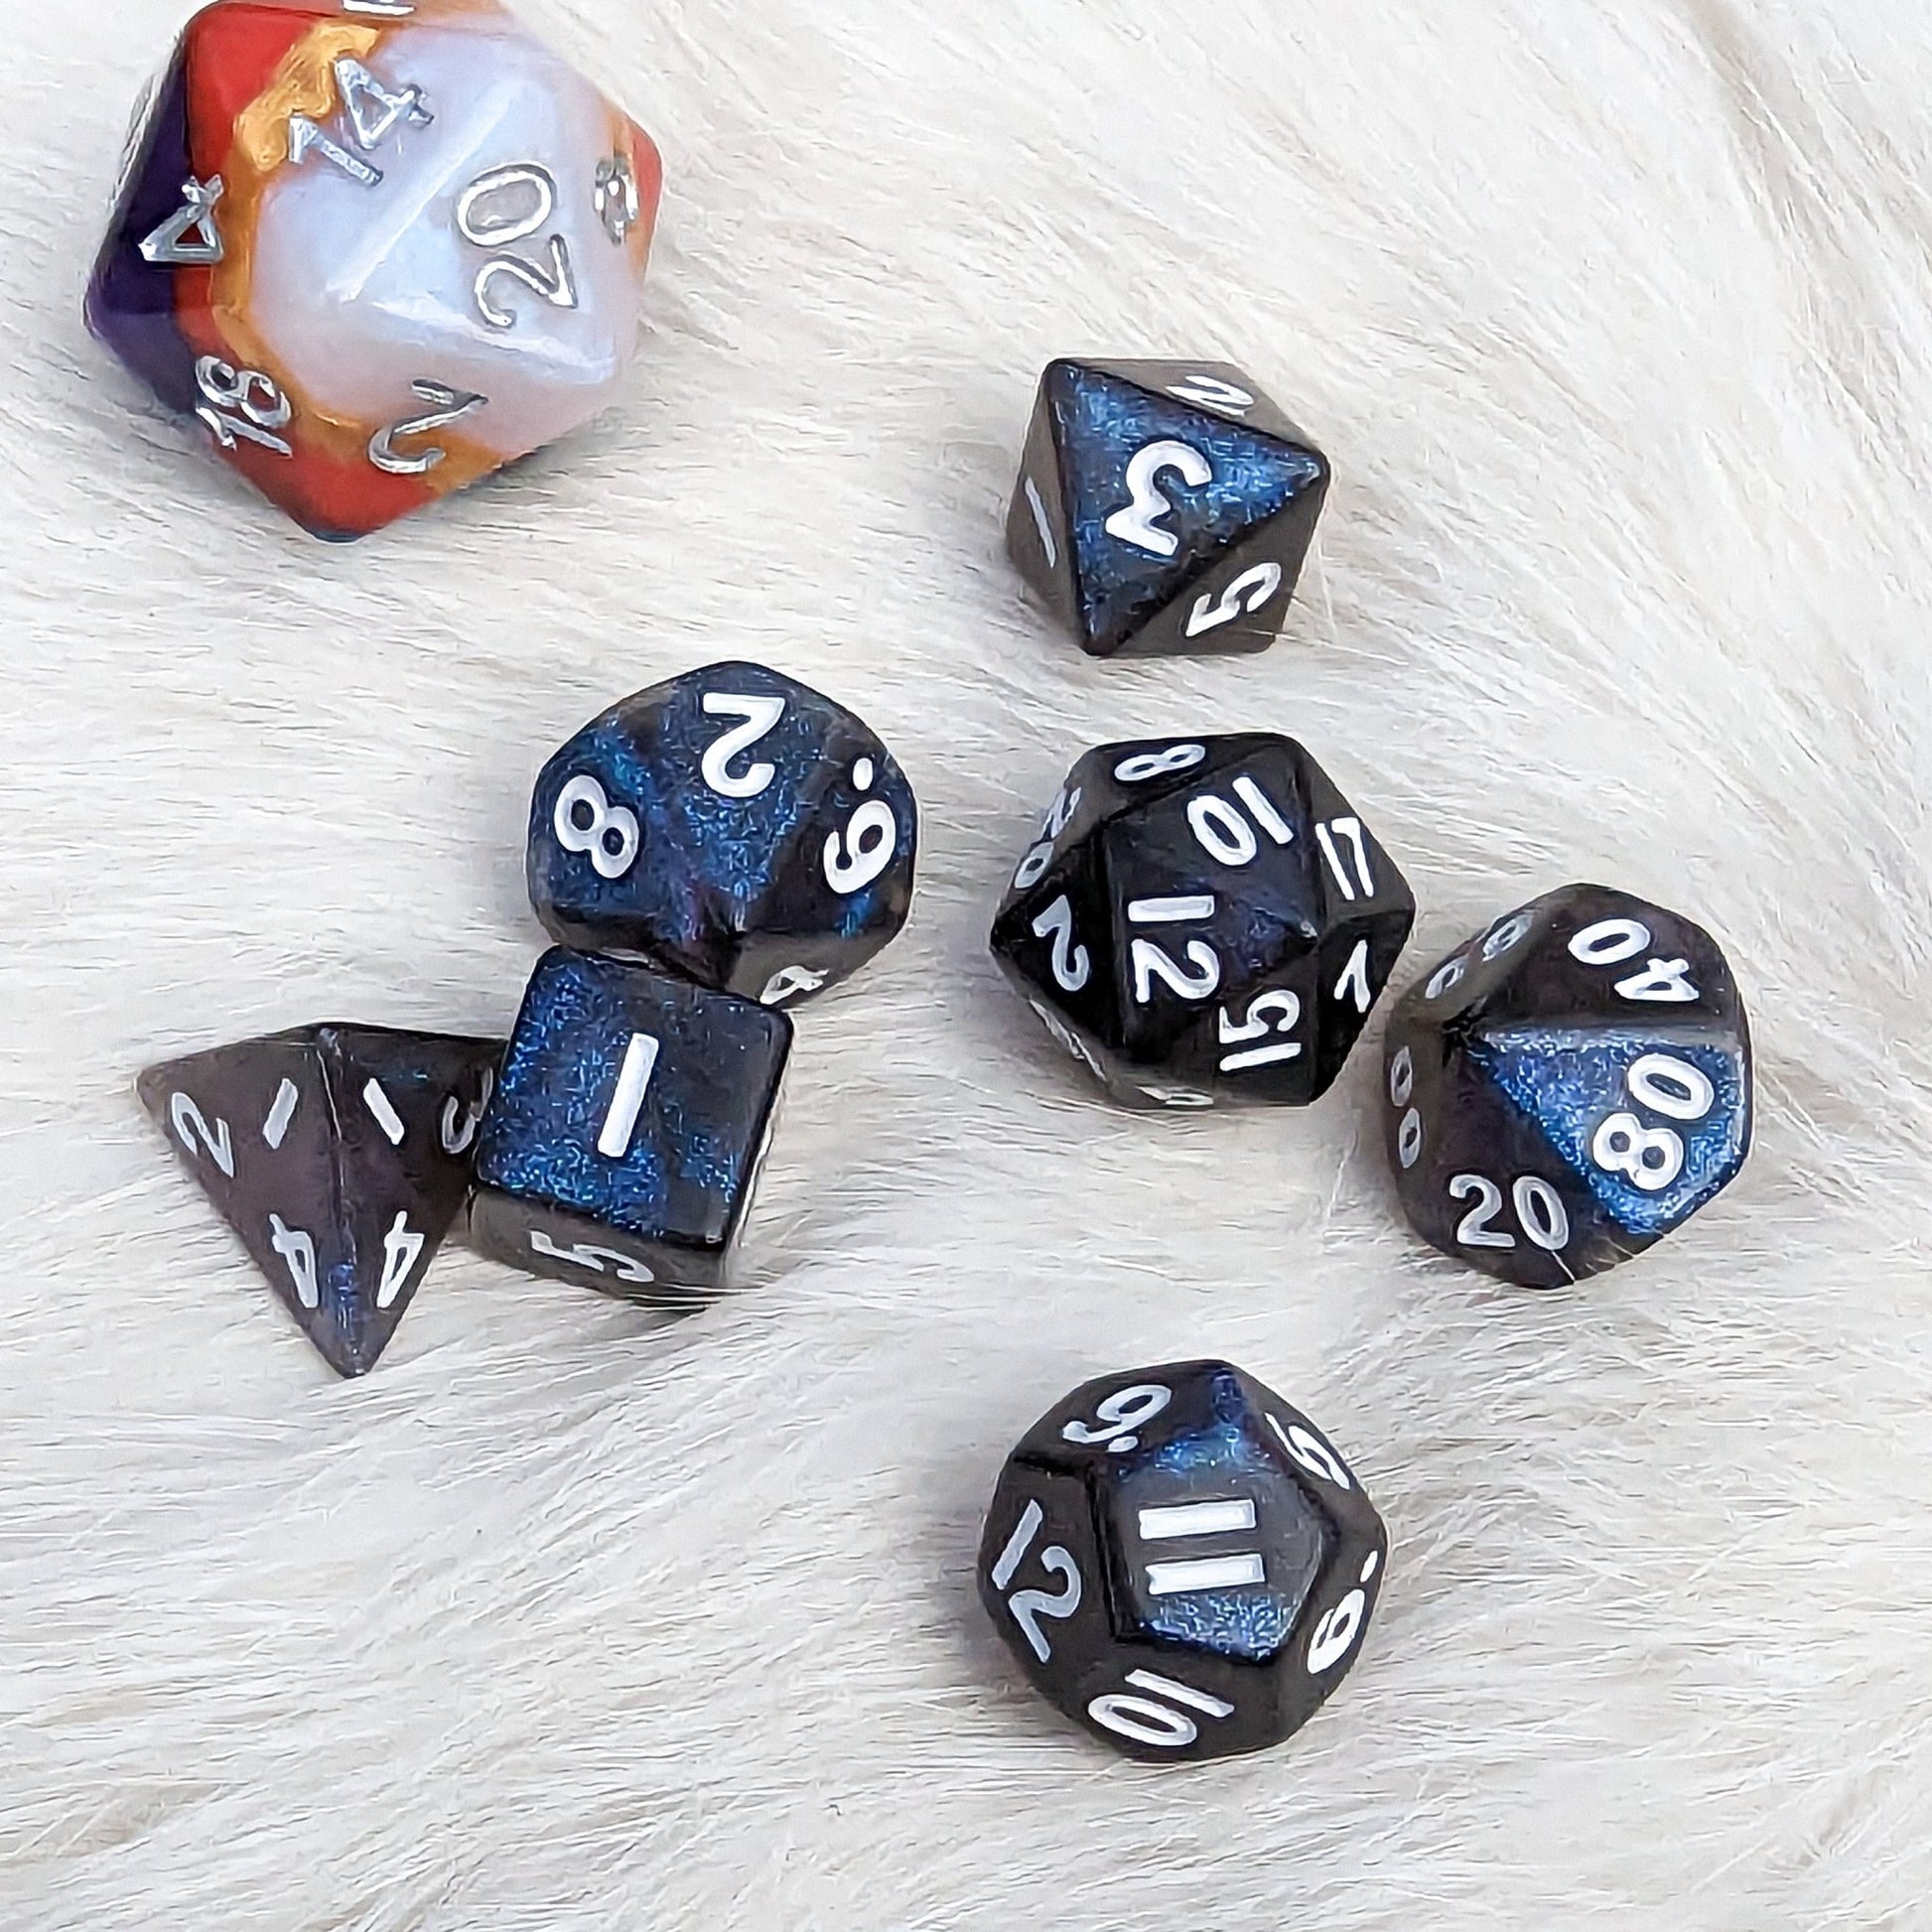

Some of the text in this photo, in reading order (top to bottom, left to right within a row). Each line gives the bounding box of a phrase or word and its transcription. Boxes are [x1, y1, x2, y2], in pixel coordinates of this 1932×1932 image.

[288, 58, 434, 187] 14
[138, 174, 222, 262] 4
[456, 162, 579, 329] 20
[195, 354, 293, 457] 18
[367, 378, 487, 474] 2
[1105, 440, 1212, 556] 3
[1185, 562, 1281, 636] 5
[701, 692, 785, 798] 2
[1114, 744, 1205, 781] 8
[553, 774, 639, 879] 8
[1186, 776, 1294, 867] 10
[1314, 817, 1374, 900] 17
[1032, 895, 1090, 991] 2
[1128, 896, 1220, 1004] 12
[1568, 918, 1700, 1002] 40
[1219, 989, 1303, 1072] 15
[170, 1091, 235, 1178] 2
[262, 1077, 299, 1150] 1
[362, 1077, 405, 1146] 1
[598, 1032, 658, 1158] 1
[1592, 1052, 1715, 1190] 80
[375, 1209, 425, 1310] 4
[529, 1229, 656, 1284] 5
[1449, 1173, 1570, 1251] 20
[268, 1212, 320, 1310] 4
[1264, 1412, 1351, 1490] 5
[991, 1499, 1082, 1664] 12
[1138, 1498, 1265, 1595] 11
[1087, 1669, 1236, 1746] 10
